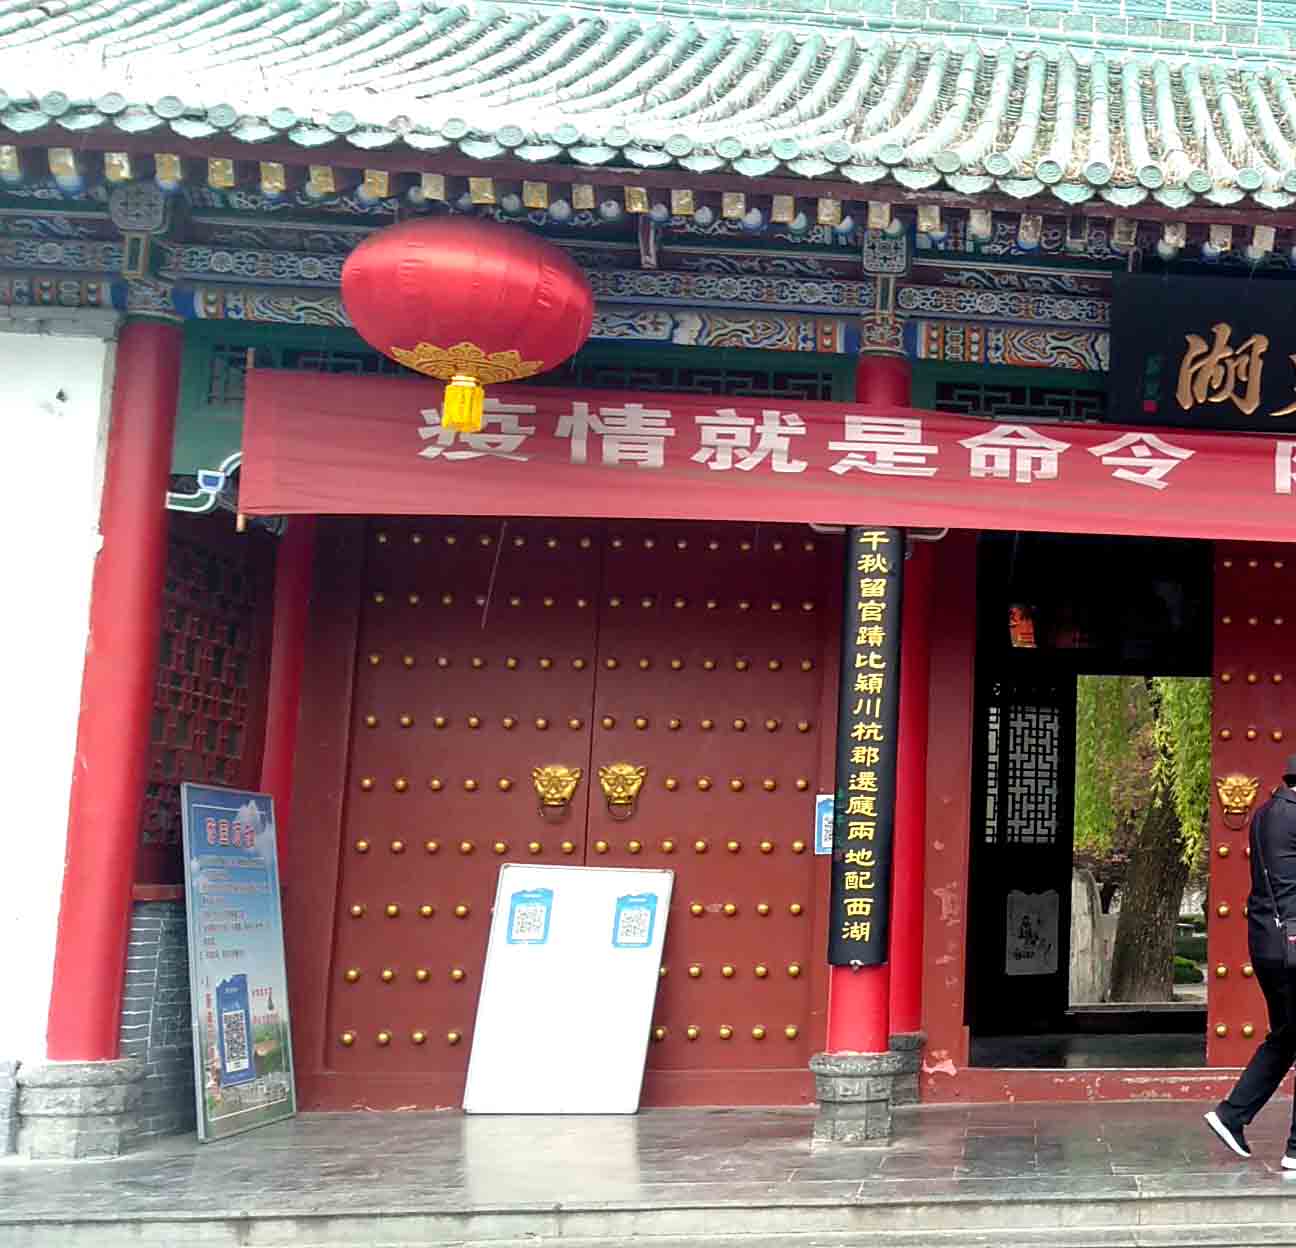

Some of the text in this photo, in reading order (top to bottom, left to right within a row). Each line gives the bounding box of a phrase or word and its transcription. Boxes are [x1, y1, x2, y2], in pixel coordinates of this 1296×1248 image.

[416, 398, 1196, 492] 疫情就是命令
